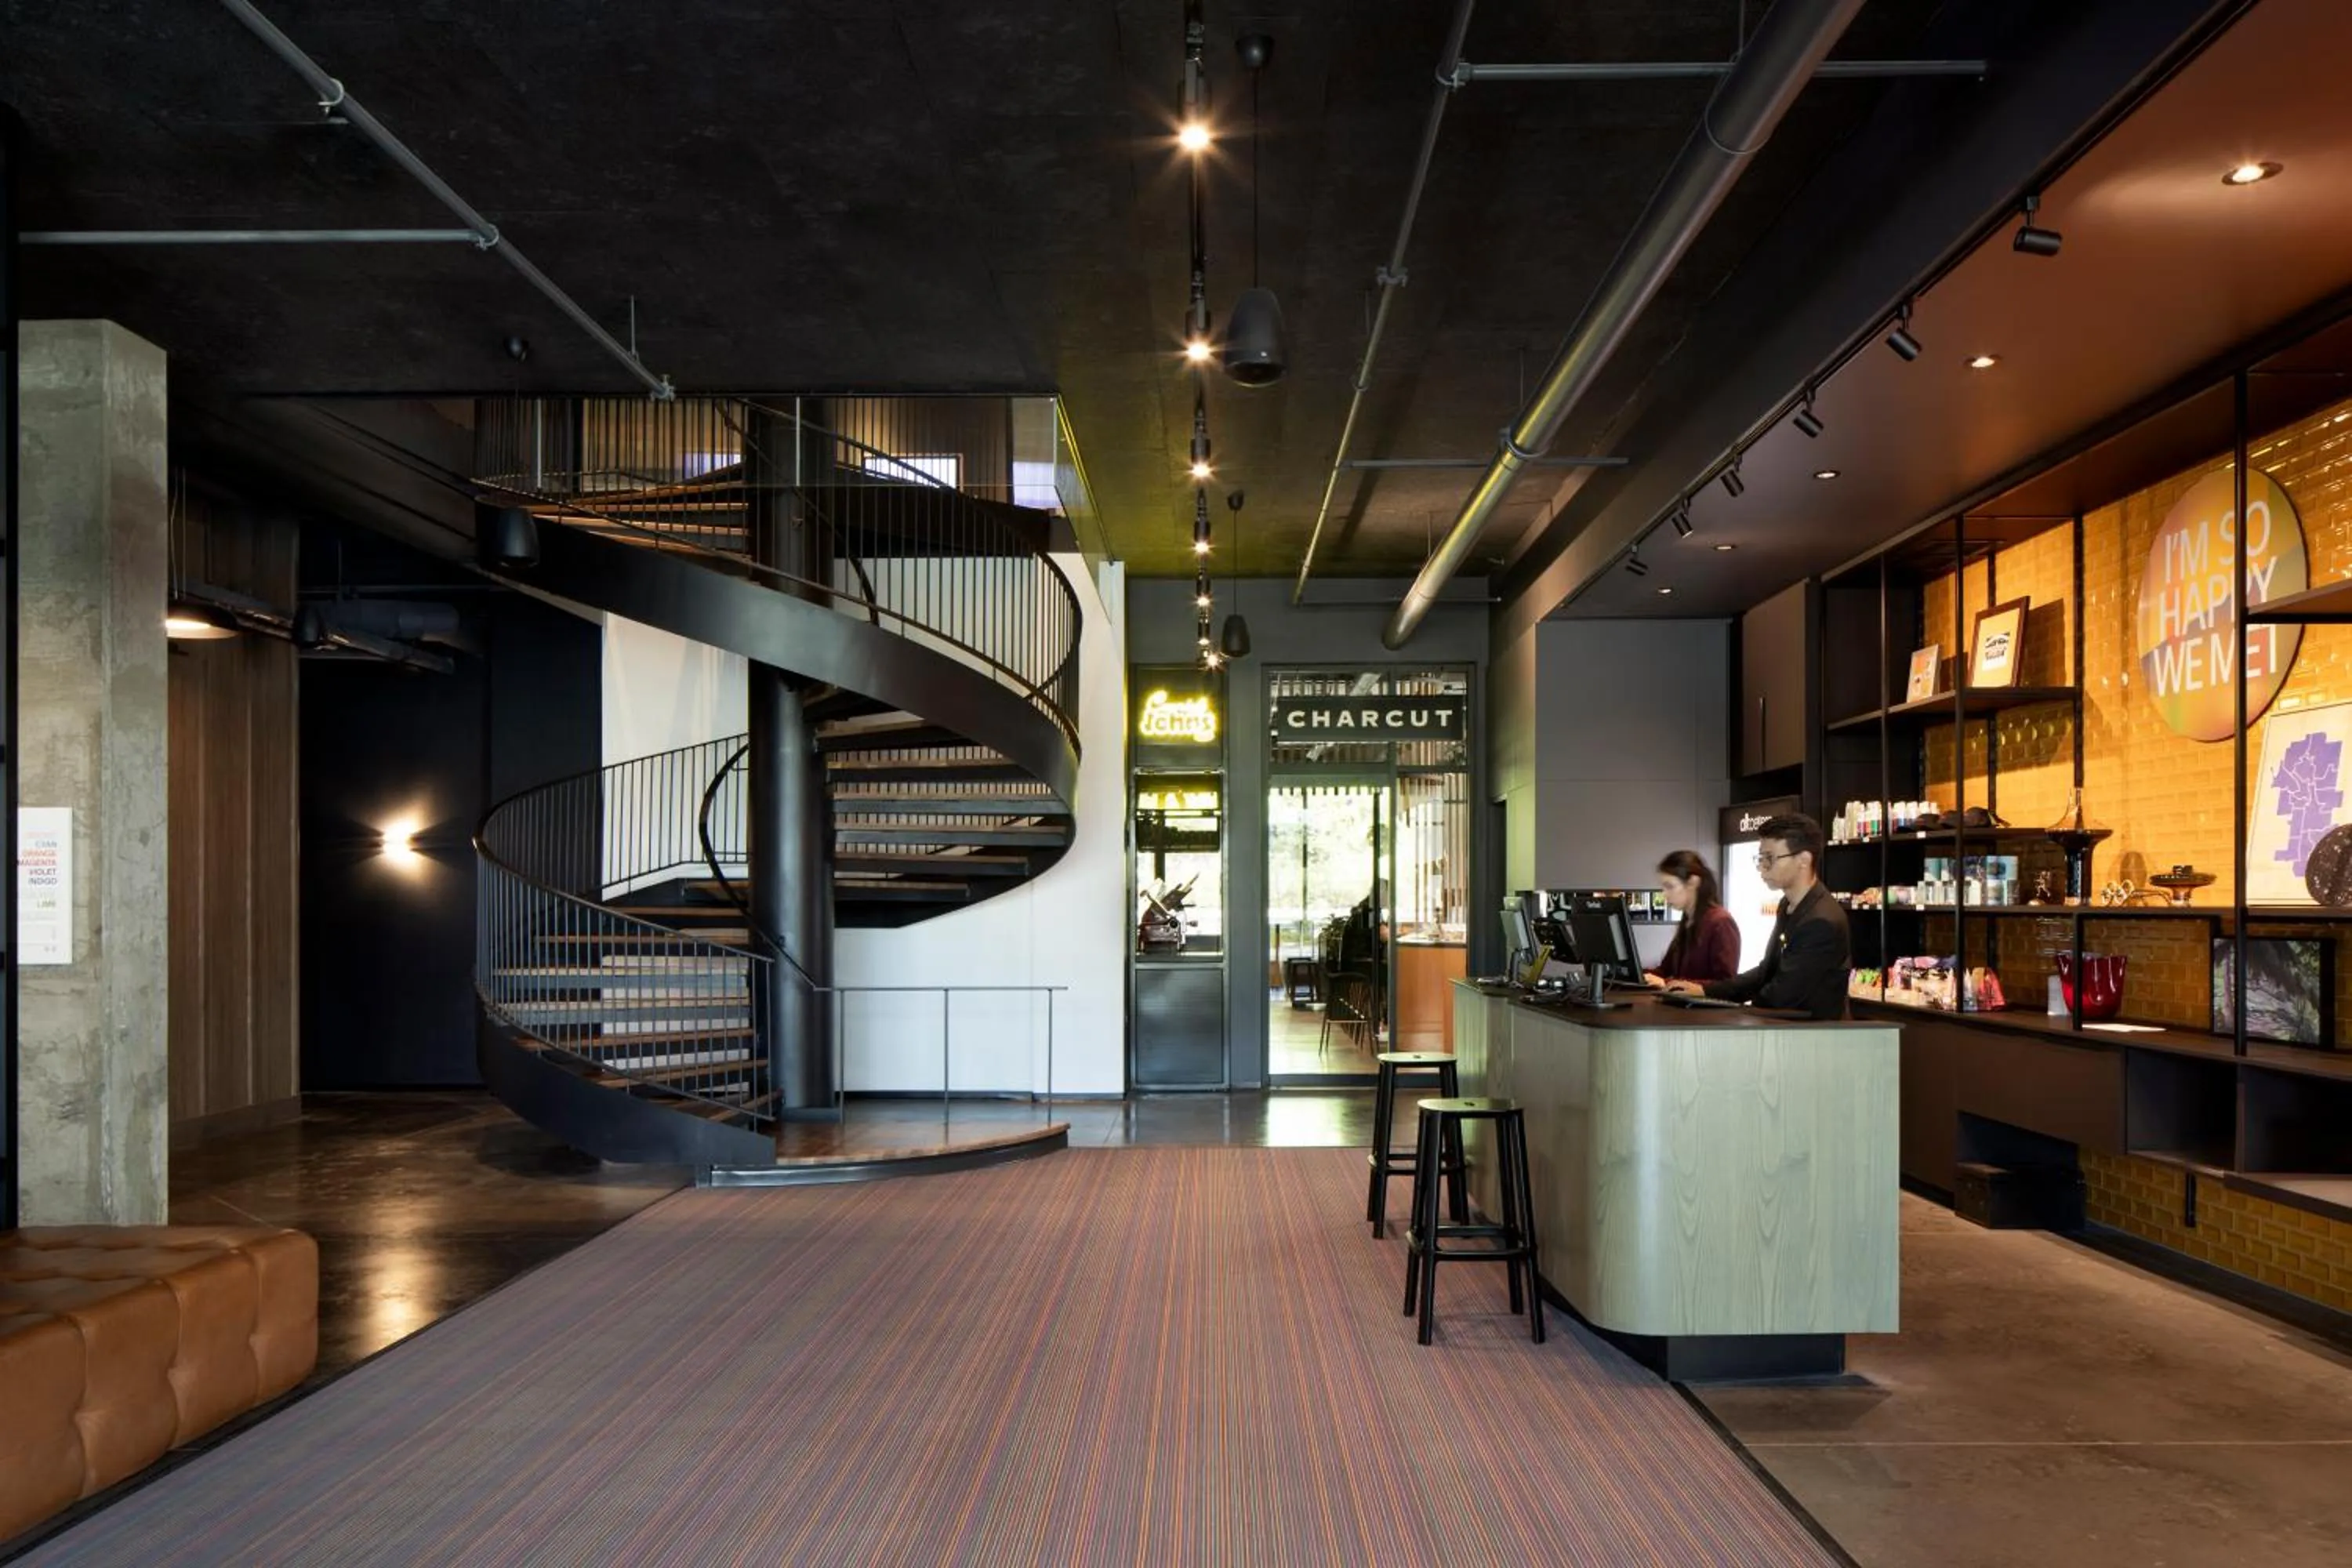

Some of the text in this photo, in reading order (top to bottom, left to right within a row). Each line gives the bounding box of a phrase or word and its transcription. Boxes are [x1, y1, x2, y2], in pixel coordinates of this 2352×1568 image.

[2165, 500, 2271, 584] I'M SO
[2154, 637, 2204, 697] WE
[1287, 710, 1453, 728] CHARCUT
